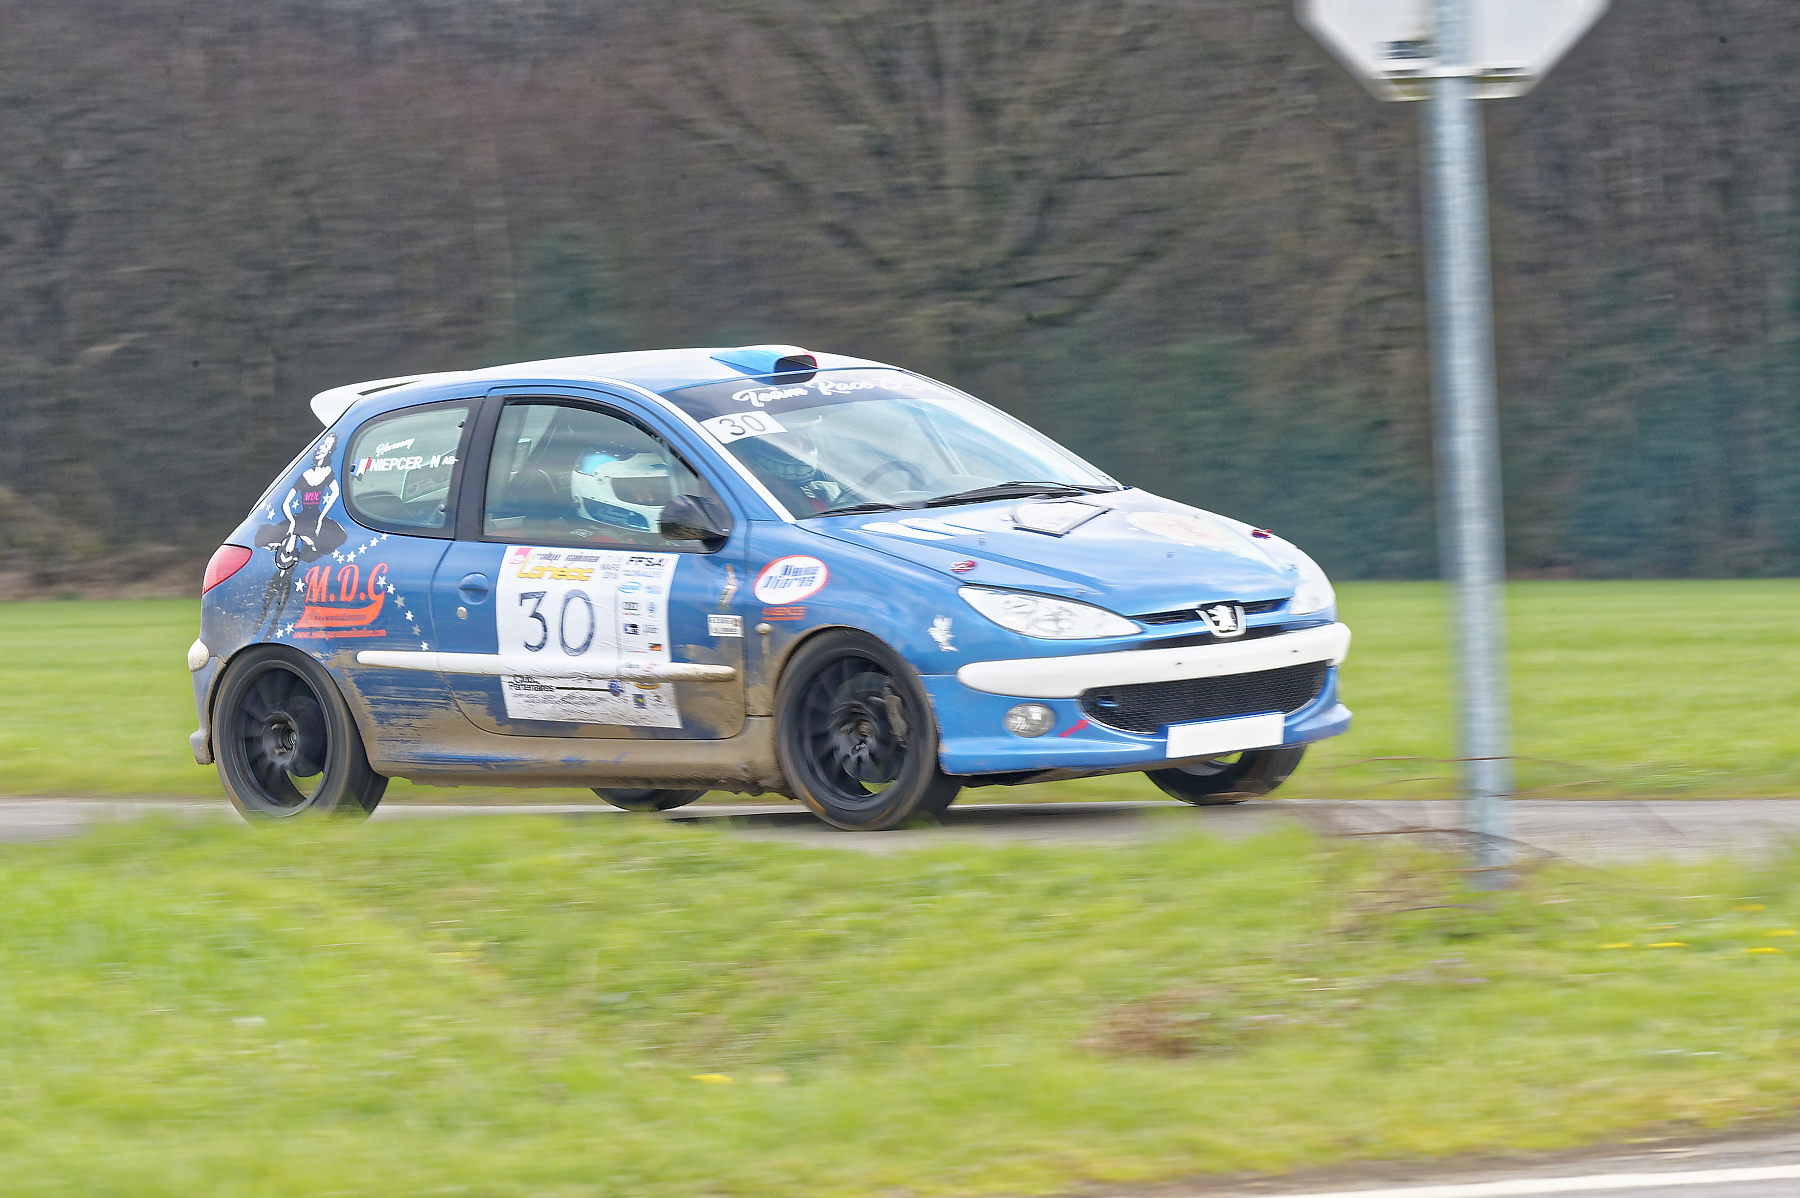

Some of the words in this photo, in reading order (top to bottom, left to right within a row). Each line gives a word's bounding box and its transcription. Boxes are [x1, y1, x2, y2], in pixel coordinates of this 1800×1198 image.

[732, 386, 808, 407] Team
[719, 415, 767, 436] 30
[518, 589, 596, 657] 30
